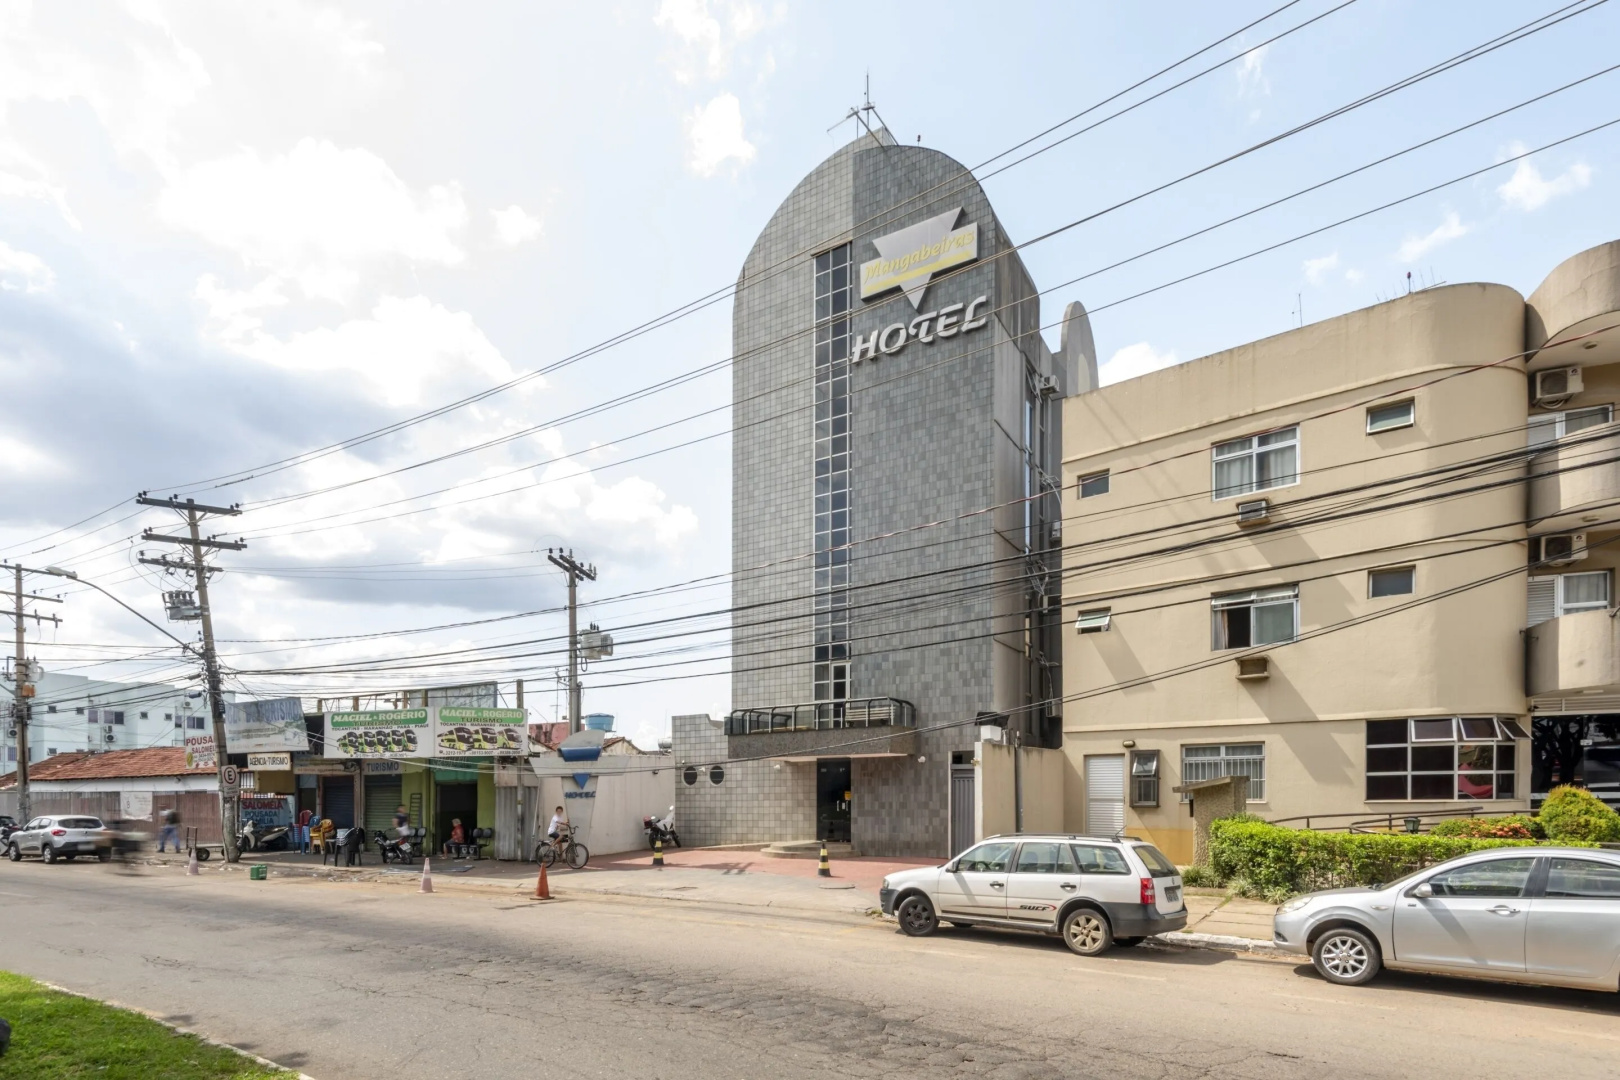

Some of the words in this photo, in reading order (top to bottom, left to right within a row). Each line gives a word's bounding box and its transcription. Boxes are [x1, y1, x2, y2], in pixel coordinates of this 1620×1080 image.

[865, 231, 974, 282] Mangabeiras
[852, 295, 987, 364] HOTEL
[333, 714, 372, 722] MACIEL
[379, 710, 426, 720] ROGÉRIO
[441, 709, 478, 717] MACIEL
[483, 709, 522, 718] ROGÉRIO
[366, 762, 399, 772] TURISMO
[227, 770, 233, 781] E
[244, 810, 278, 818] POUSADA
